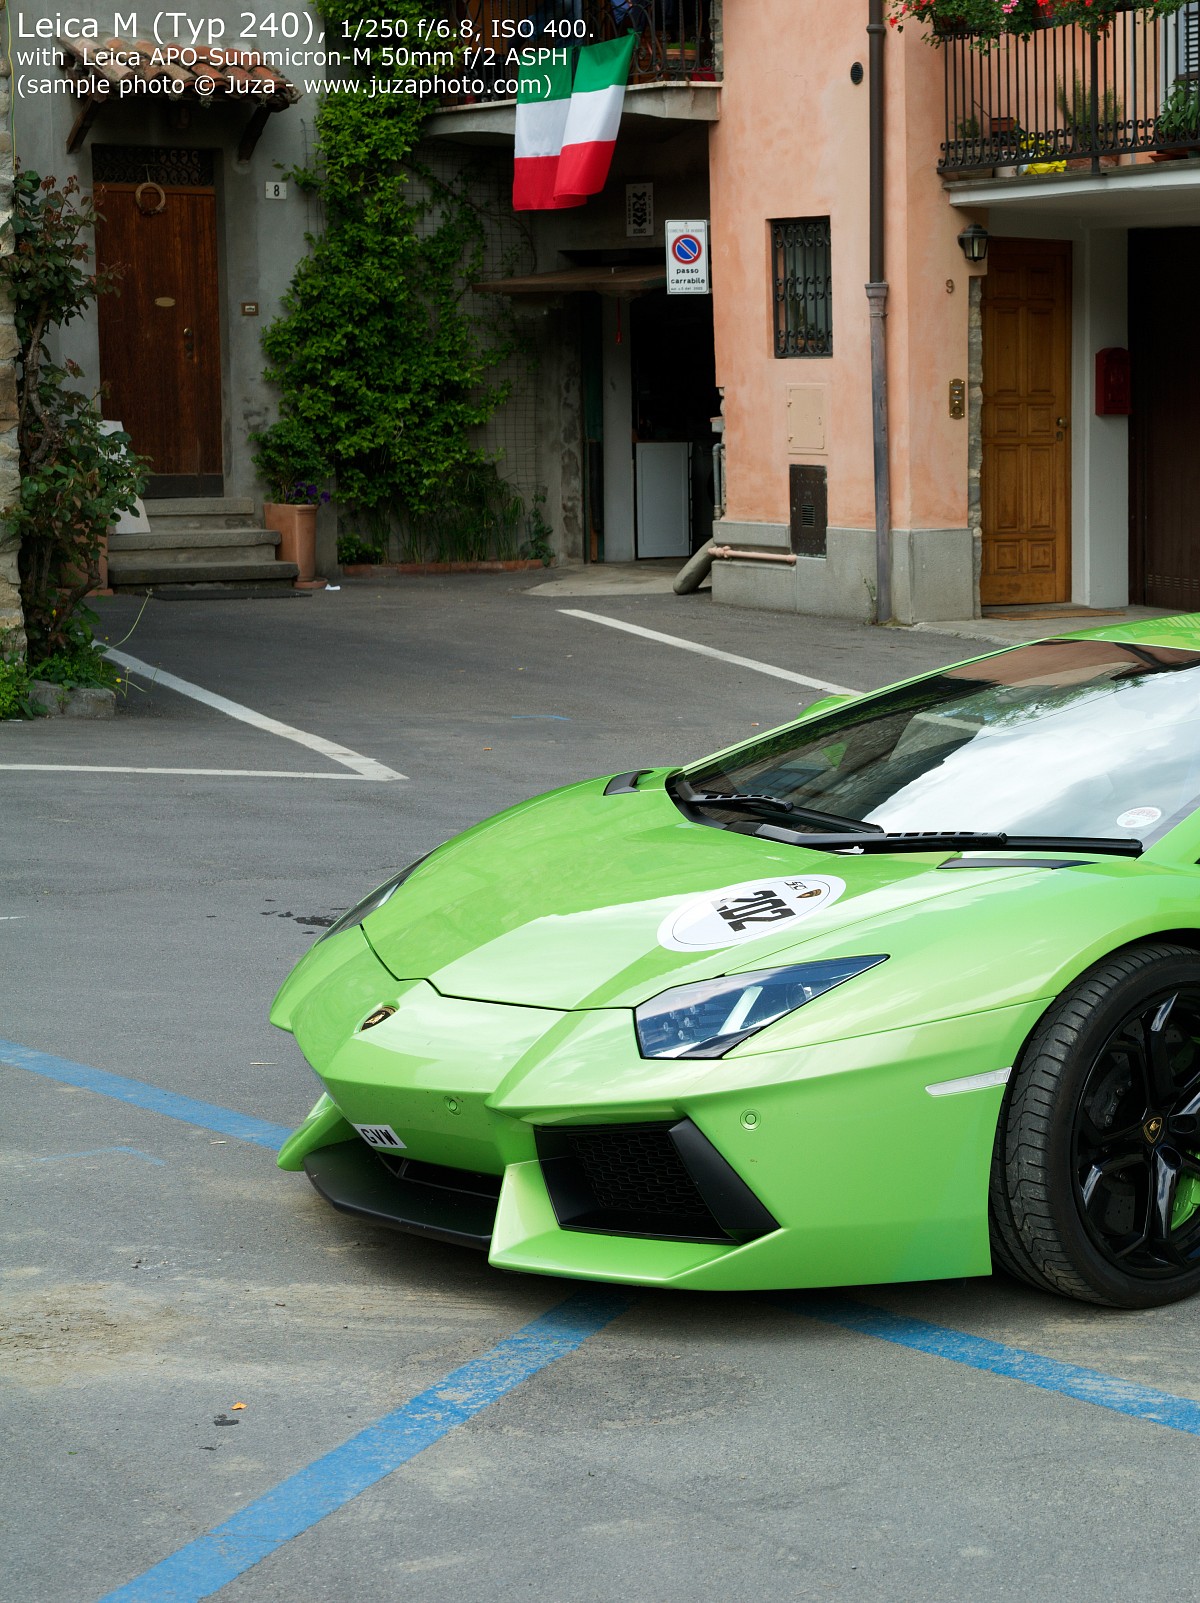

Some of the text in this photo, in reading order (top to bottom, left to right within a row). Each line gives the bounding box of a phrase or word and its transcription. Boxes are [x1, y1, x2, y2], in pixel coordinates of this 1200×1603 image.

[273, 184, 280, 197] 8
[944, 278, 955, 294] 9
[711, 890, 797, 932] 202
